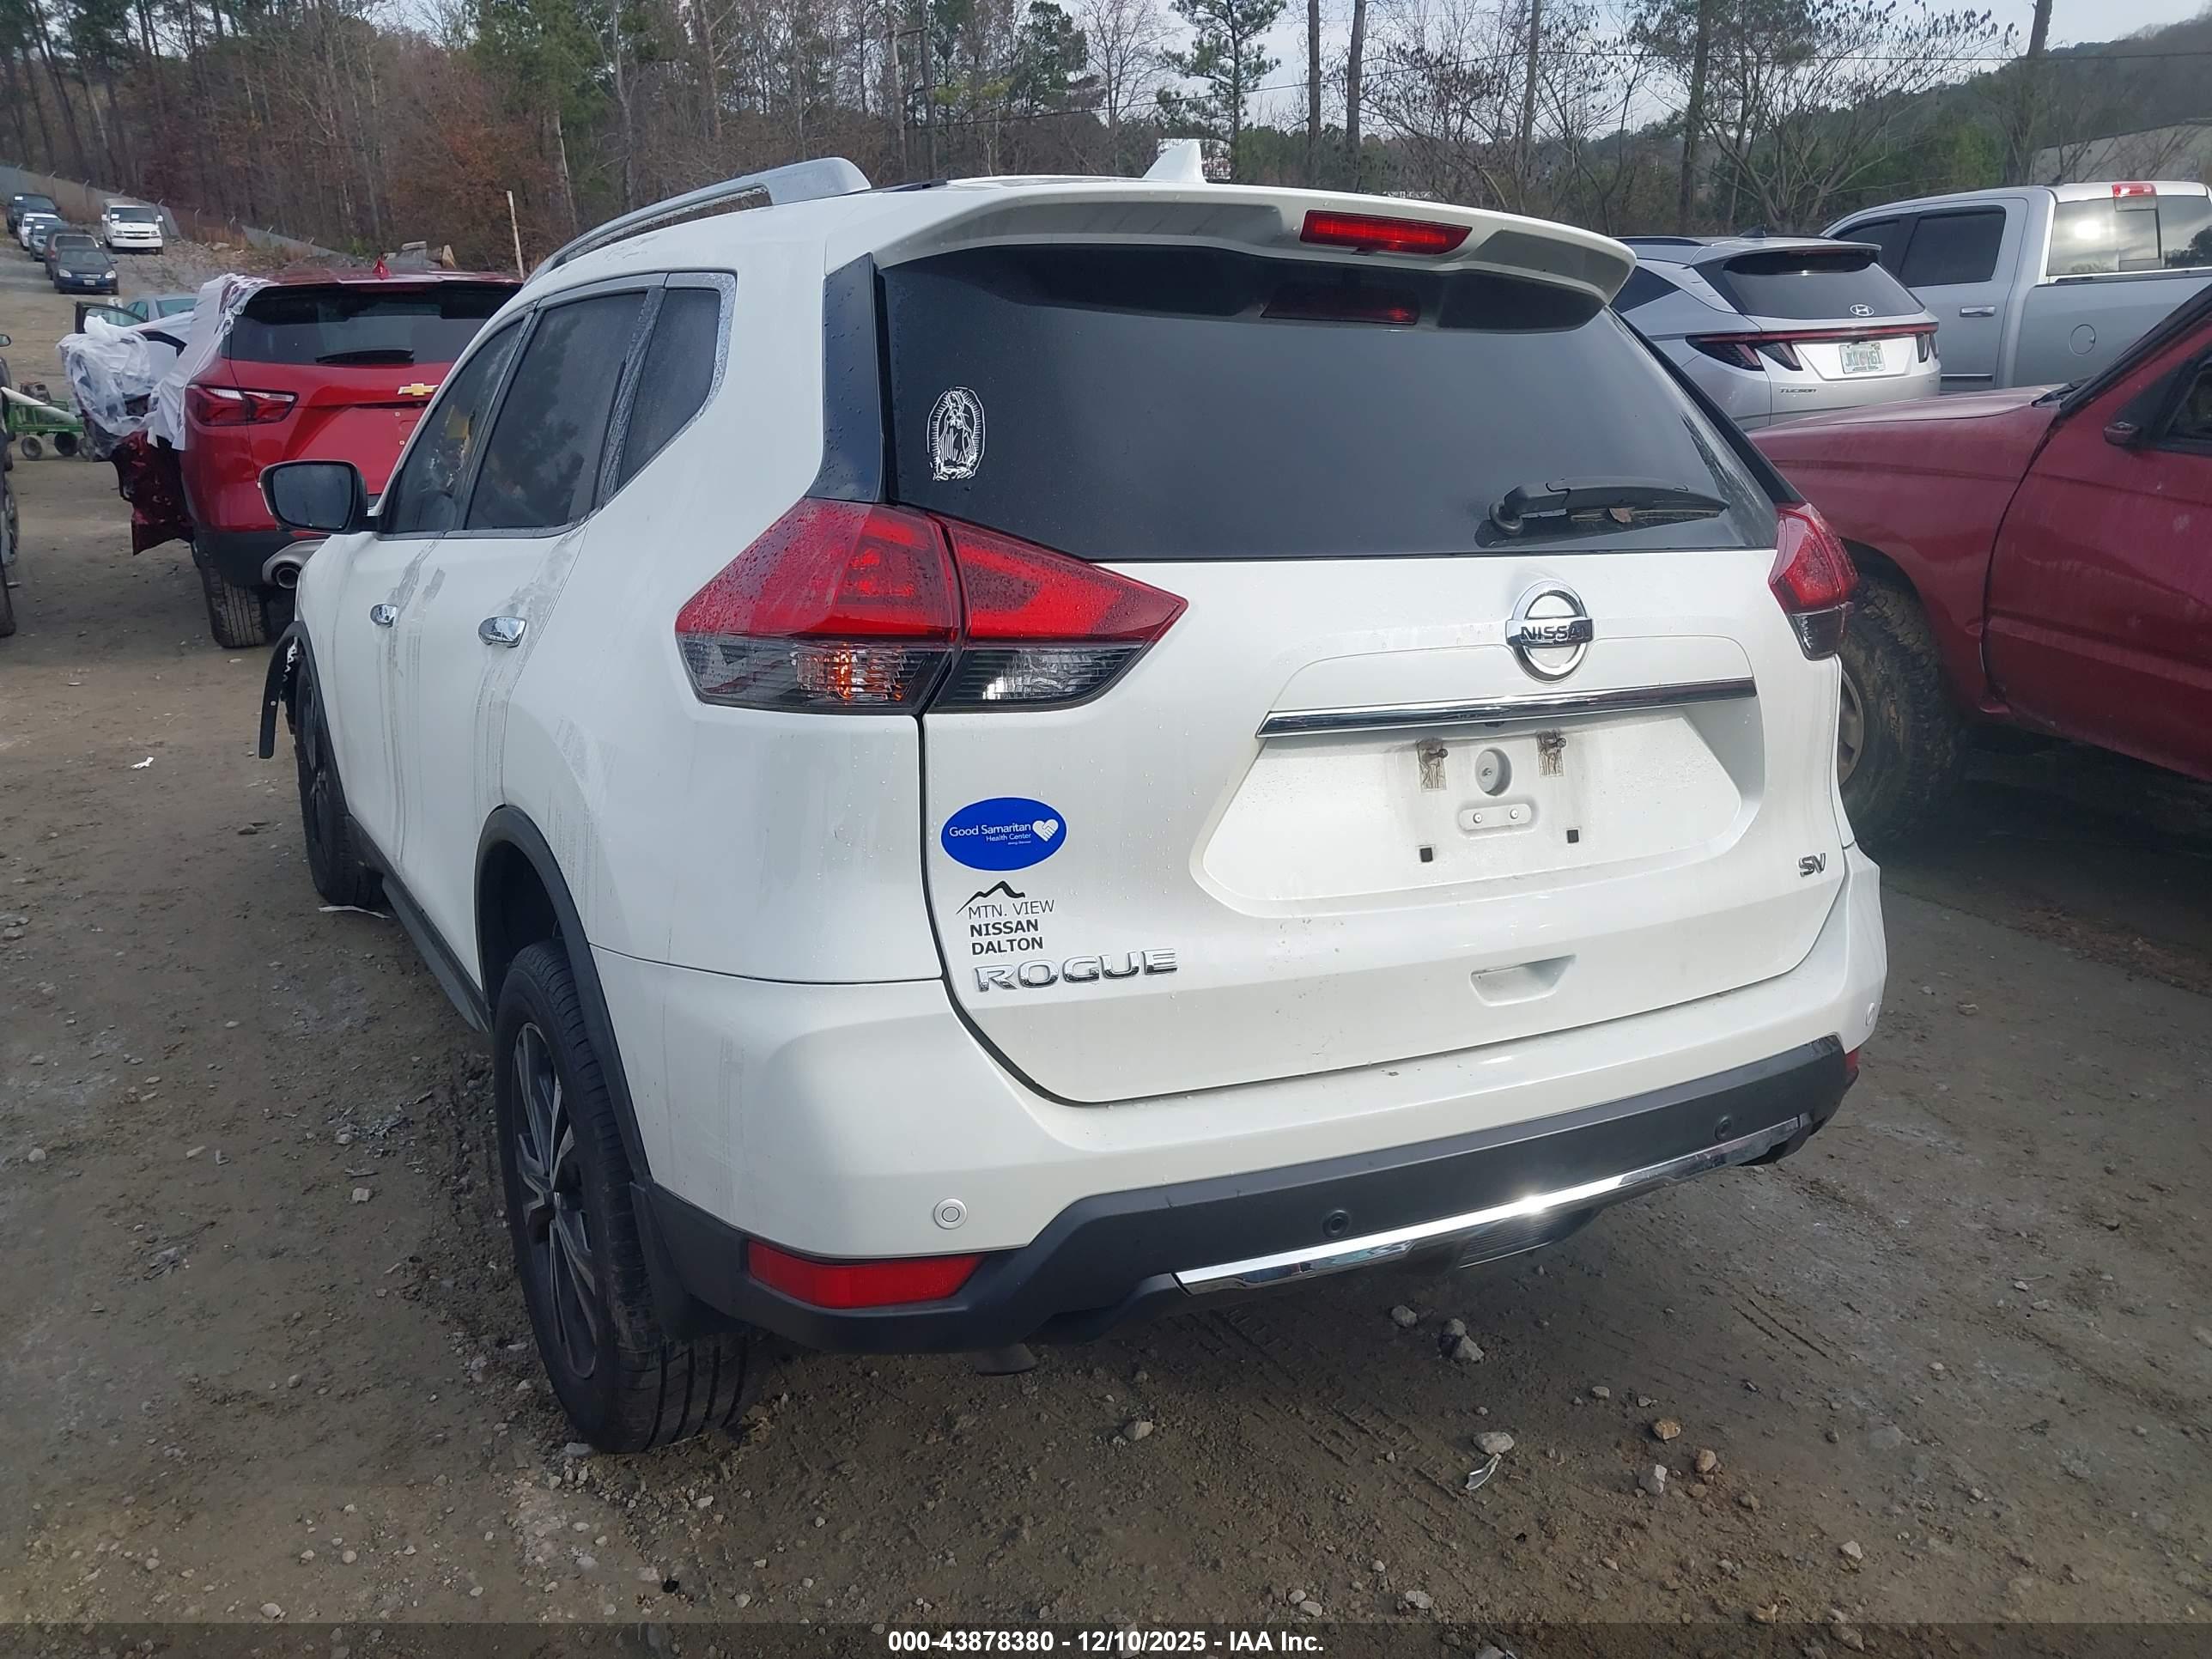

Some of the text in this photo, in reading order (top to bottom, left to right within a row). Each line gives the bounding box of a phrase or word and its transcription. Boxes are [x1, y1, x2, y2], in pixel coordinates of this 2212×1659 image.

[1520, 625, 1591, 641] NISSAN
[949, 823, 1031, 836] Good Samaritan
[1799, 853, 1826, 877] SV
[969, 899, 1054, 920] MTN. VIEW
[969, 919, 1039, 938] NISSAN
[971, 937, 1043, 956] DALTON
[974, 948, 1178, 992] ROGUE
